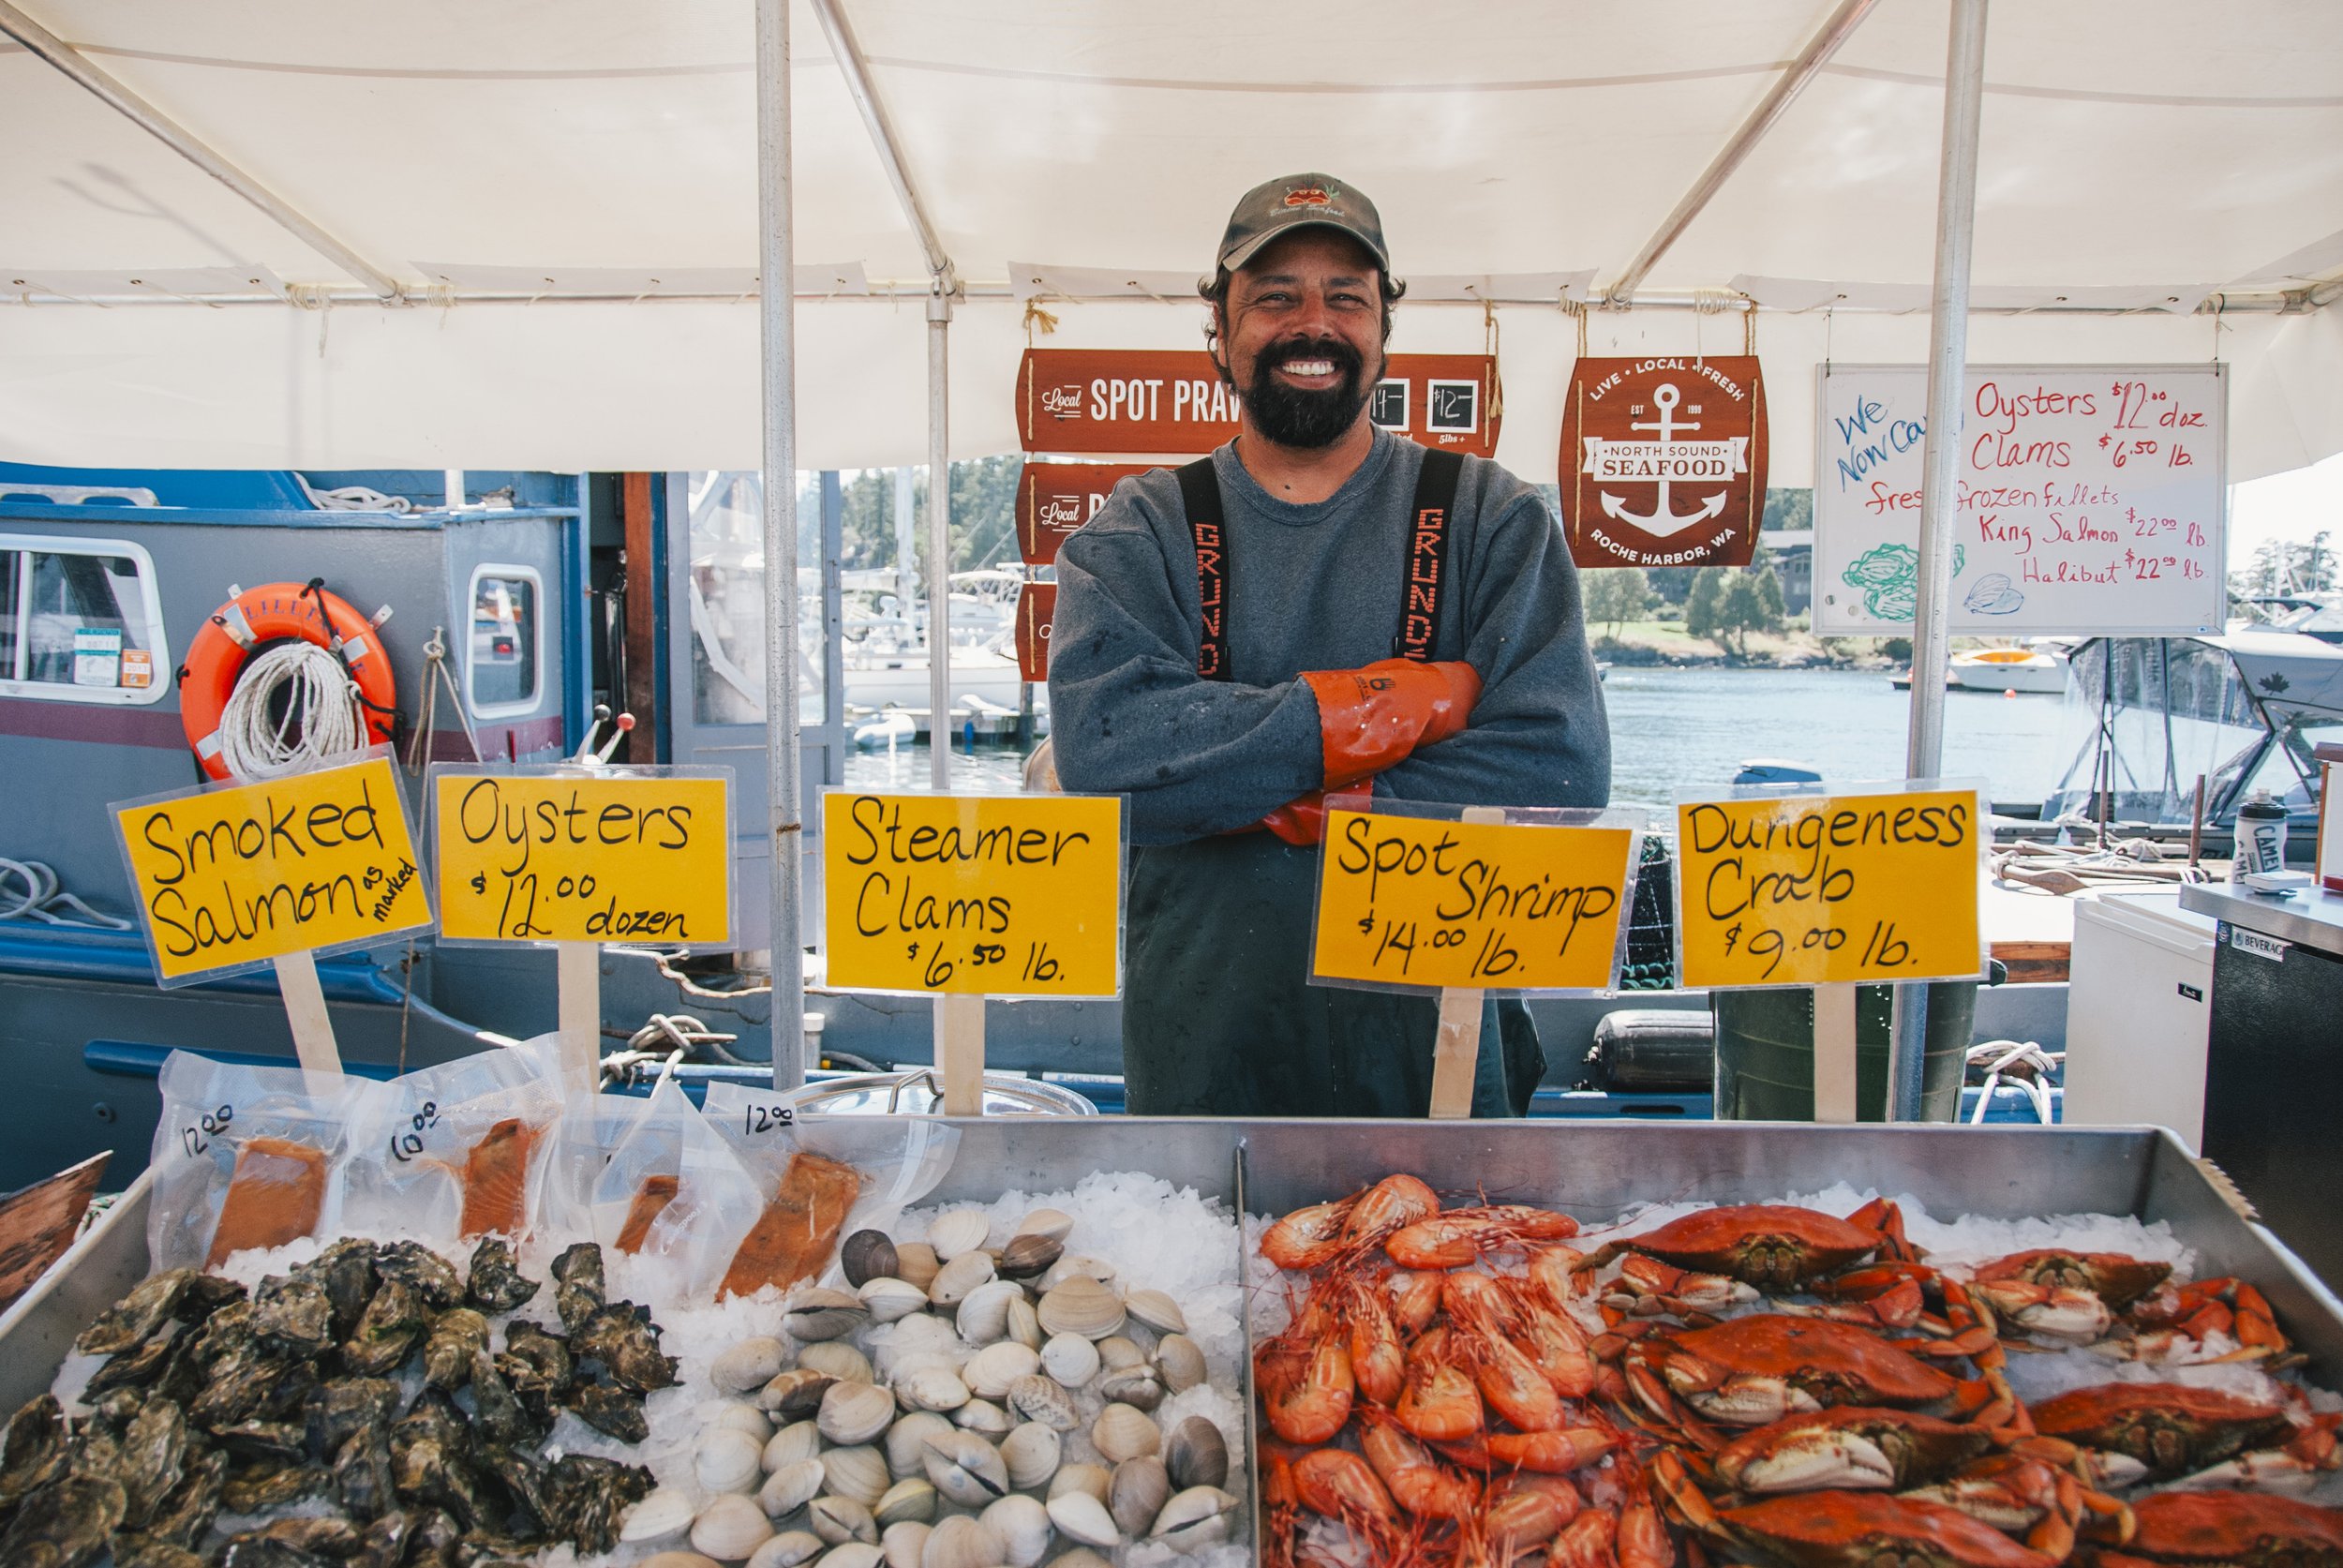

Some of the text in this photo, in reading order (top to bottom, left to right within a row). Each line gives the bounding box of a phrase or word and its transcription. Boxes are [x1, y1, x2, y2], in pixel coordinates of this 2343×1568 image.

[1041, 387, 1082, 412] Local
[1090, 378, 1163, 422] SPOT
[1589, 358, 1745, 402] LIVE LOCAL FRESH
[1630, 404, 1702, 415] EST 1999
[1834, 394, 1888, 445] We
[1976, 382, 2097, 435] Oysters
[1602, 459, 1726, 476] SEAFOOD
[1610, 446, 1722, 456] NORTH SOUND
[1972, 433, 2070, 470] Clams
[2098, 433, 2157, 468] $6.50
[2168, 443, 2193, 468] lb.
[1040, 502, 1080, 526] Local
[1865, 481, 1923, 515] fres
[2044, 481, 2119, 508] fillets
[1590, 528, 1737, 566] ROCHE HARBOR, WA
[1979, 515, 2031, 555] King
[2042, 512, 2119, 543] Salmon
[2022, 556, 2122, 584] Halibut
[143, 778, 385, 886] Smoked
[460, 778, 693, 878] Oysters
[847, 796, 1090, 867] Steamer
[1687, 803, 1968, 883] Dungeness
[150, 864, 383, 957] Salmon as
[372, 857, 418, 923] marked
[857, 871, 1011, 937] Clams
[1337, 816, 1617, 958] Spot Shrimp
[1704, 853, 1856, 922] Crab
[586, 895, 691, 938] dozen
[906, 940, 1066, 989] $6.50 lb.
[1357, 908, 1526, 979] $14.00 lb.
[1724, 918, 1920, 981] $9.00 lb.
